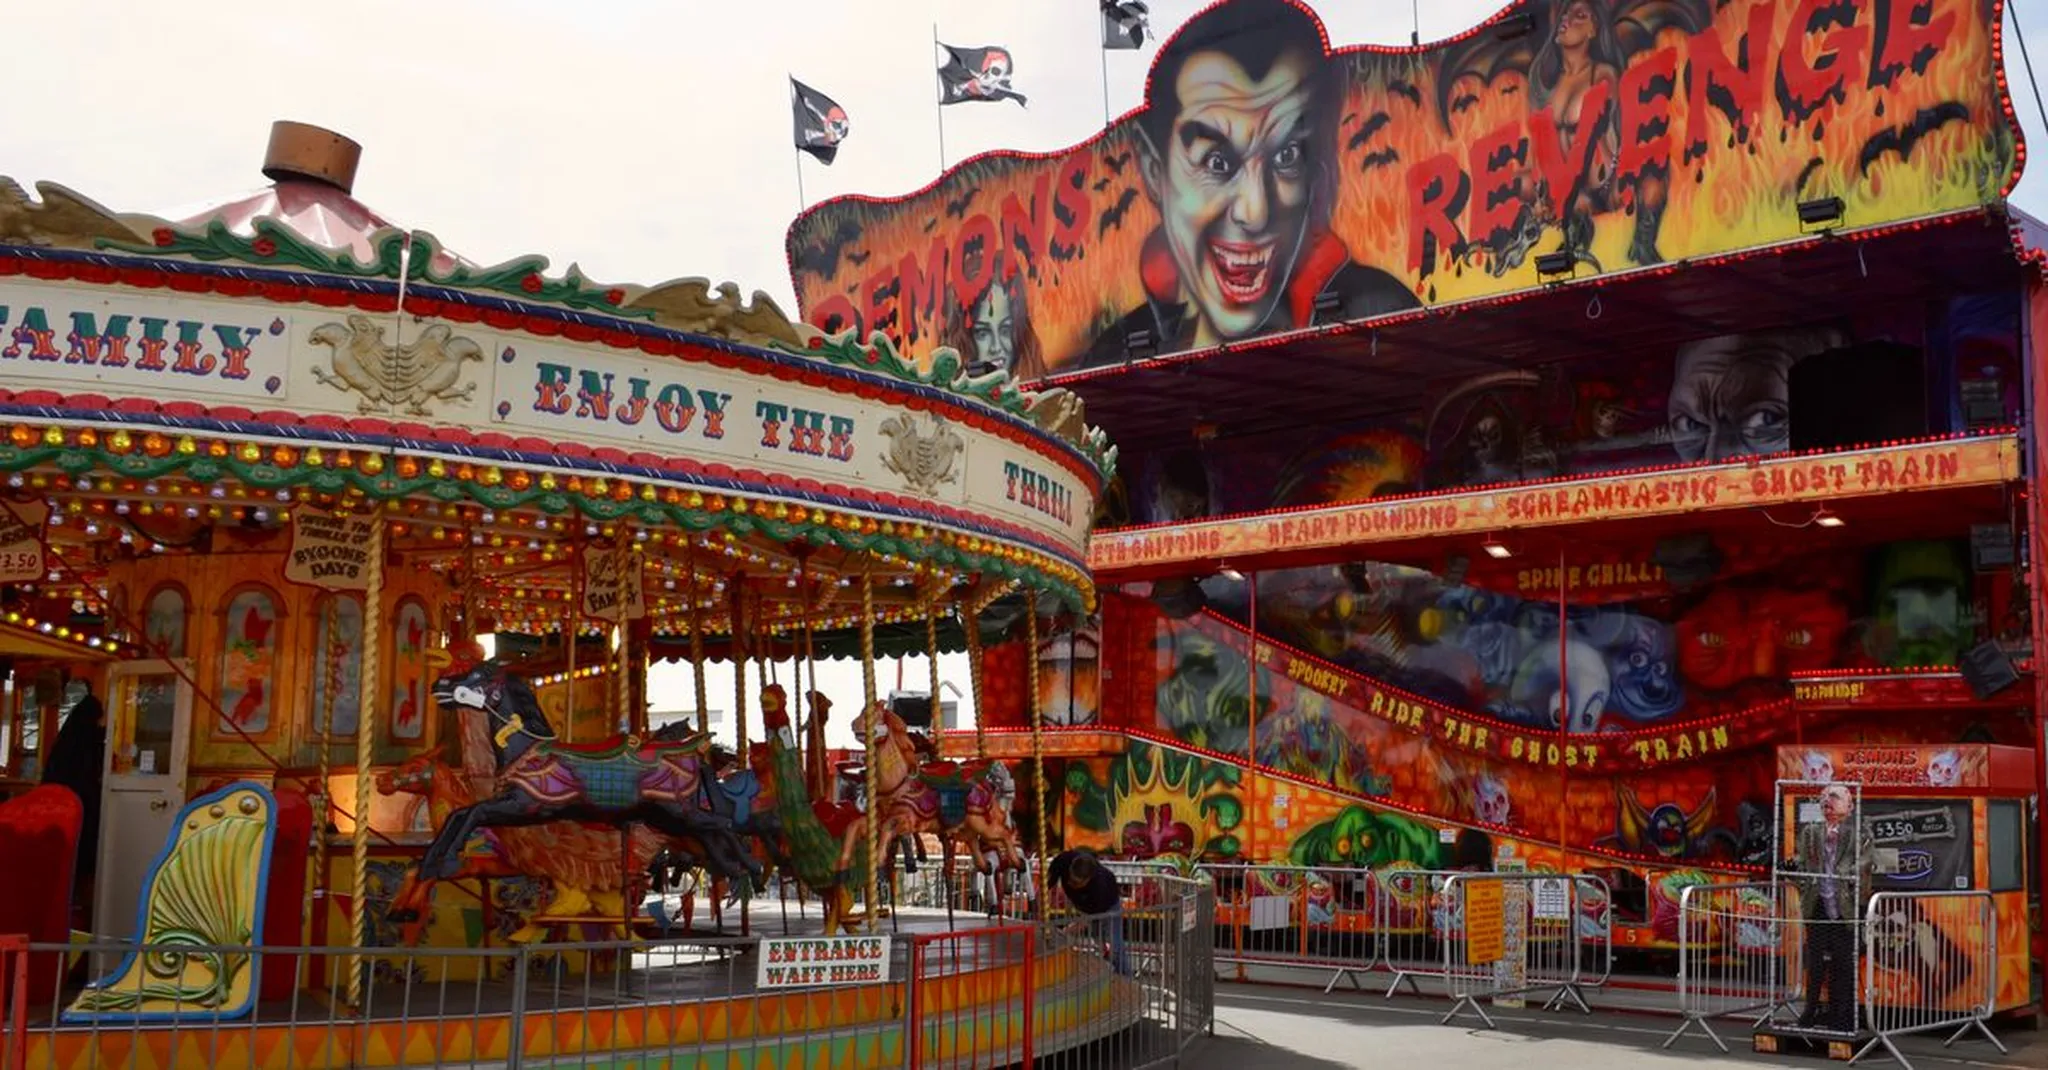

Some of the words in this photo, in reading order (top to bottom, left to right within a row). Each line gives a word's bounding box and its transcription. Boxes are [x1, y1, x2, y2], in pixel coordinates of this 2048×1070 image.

[1405, 0, 1958, 276] REVENGE
[0, 304, 261, 380] AMILY
[534, 362, 733, 439] ENJOY
[756, 401, 855, 462] THE
[1003, 459, 1073, 527] THRILL
[1267, 516, 1339, 544] HEART
[1346, 504, 1458, 539] POUNDING
[1506, 475, 1718, 519] SCREAMTASTIC
[1750, 463, 1847, 498] GHOST
[1856, 451, 1959, 487] TRAIN
[0, 553, 37, 568] 3.50
[294, 546, 367, 566] BYGONE
[311, 561, 360, 579] DAYS
[587, 591, 637, 613] FAMY
[1371, 691, 1425, 728] RIDE
[1443, 716, 1489, 749] THE
[1510, 736, 1600, 769] GHOST
[1635, 725, 1729, 762] TRAIN
[1843, 749, 1919, 768] DEMONS
[1898, 855, 1934, 873] PEN
[1626, 929, 1637, 943] 5
[768, 939, 883, 963] ENTRANCE
[766, 965, 827, 985] WAIT
[829, 963, 881, 983] HERE
